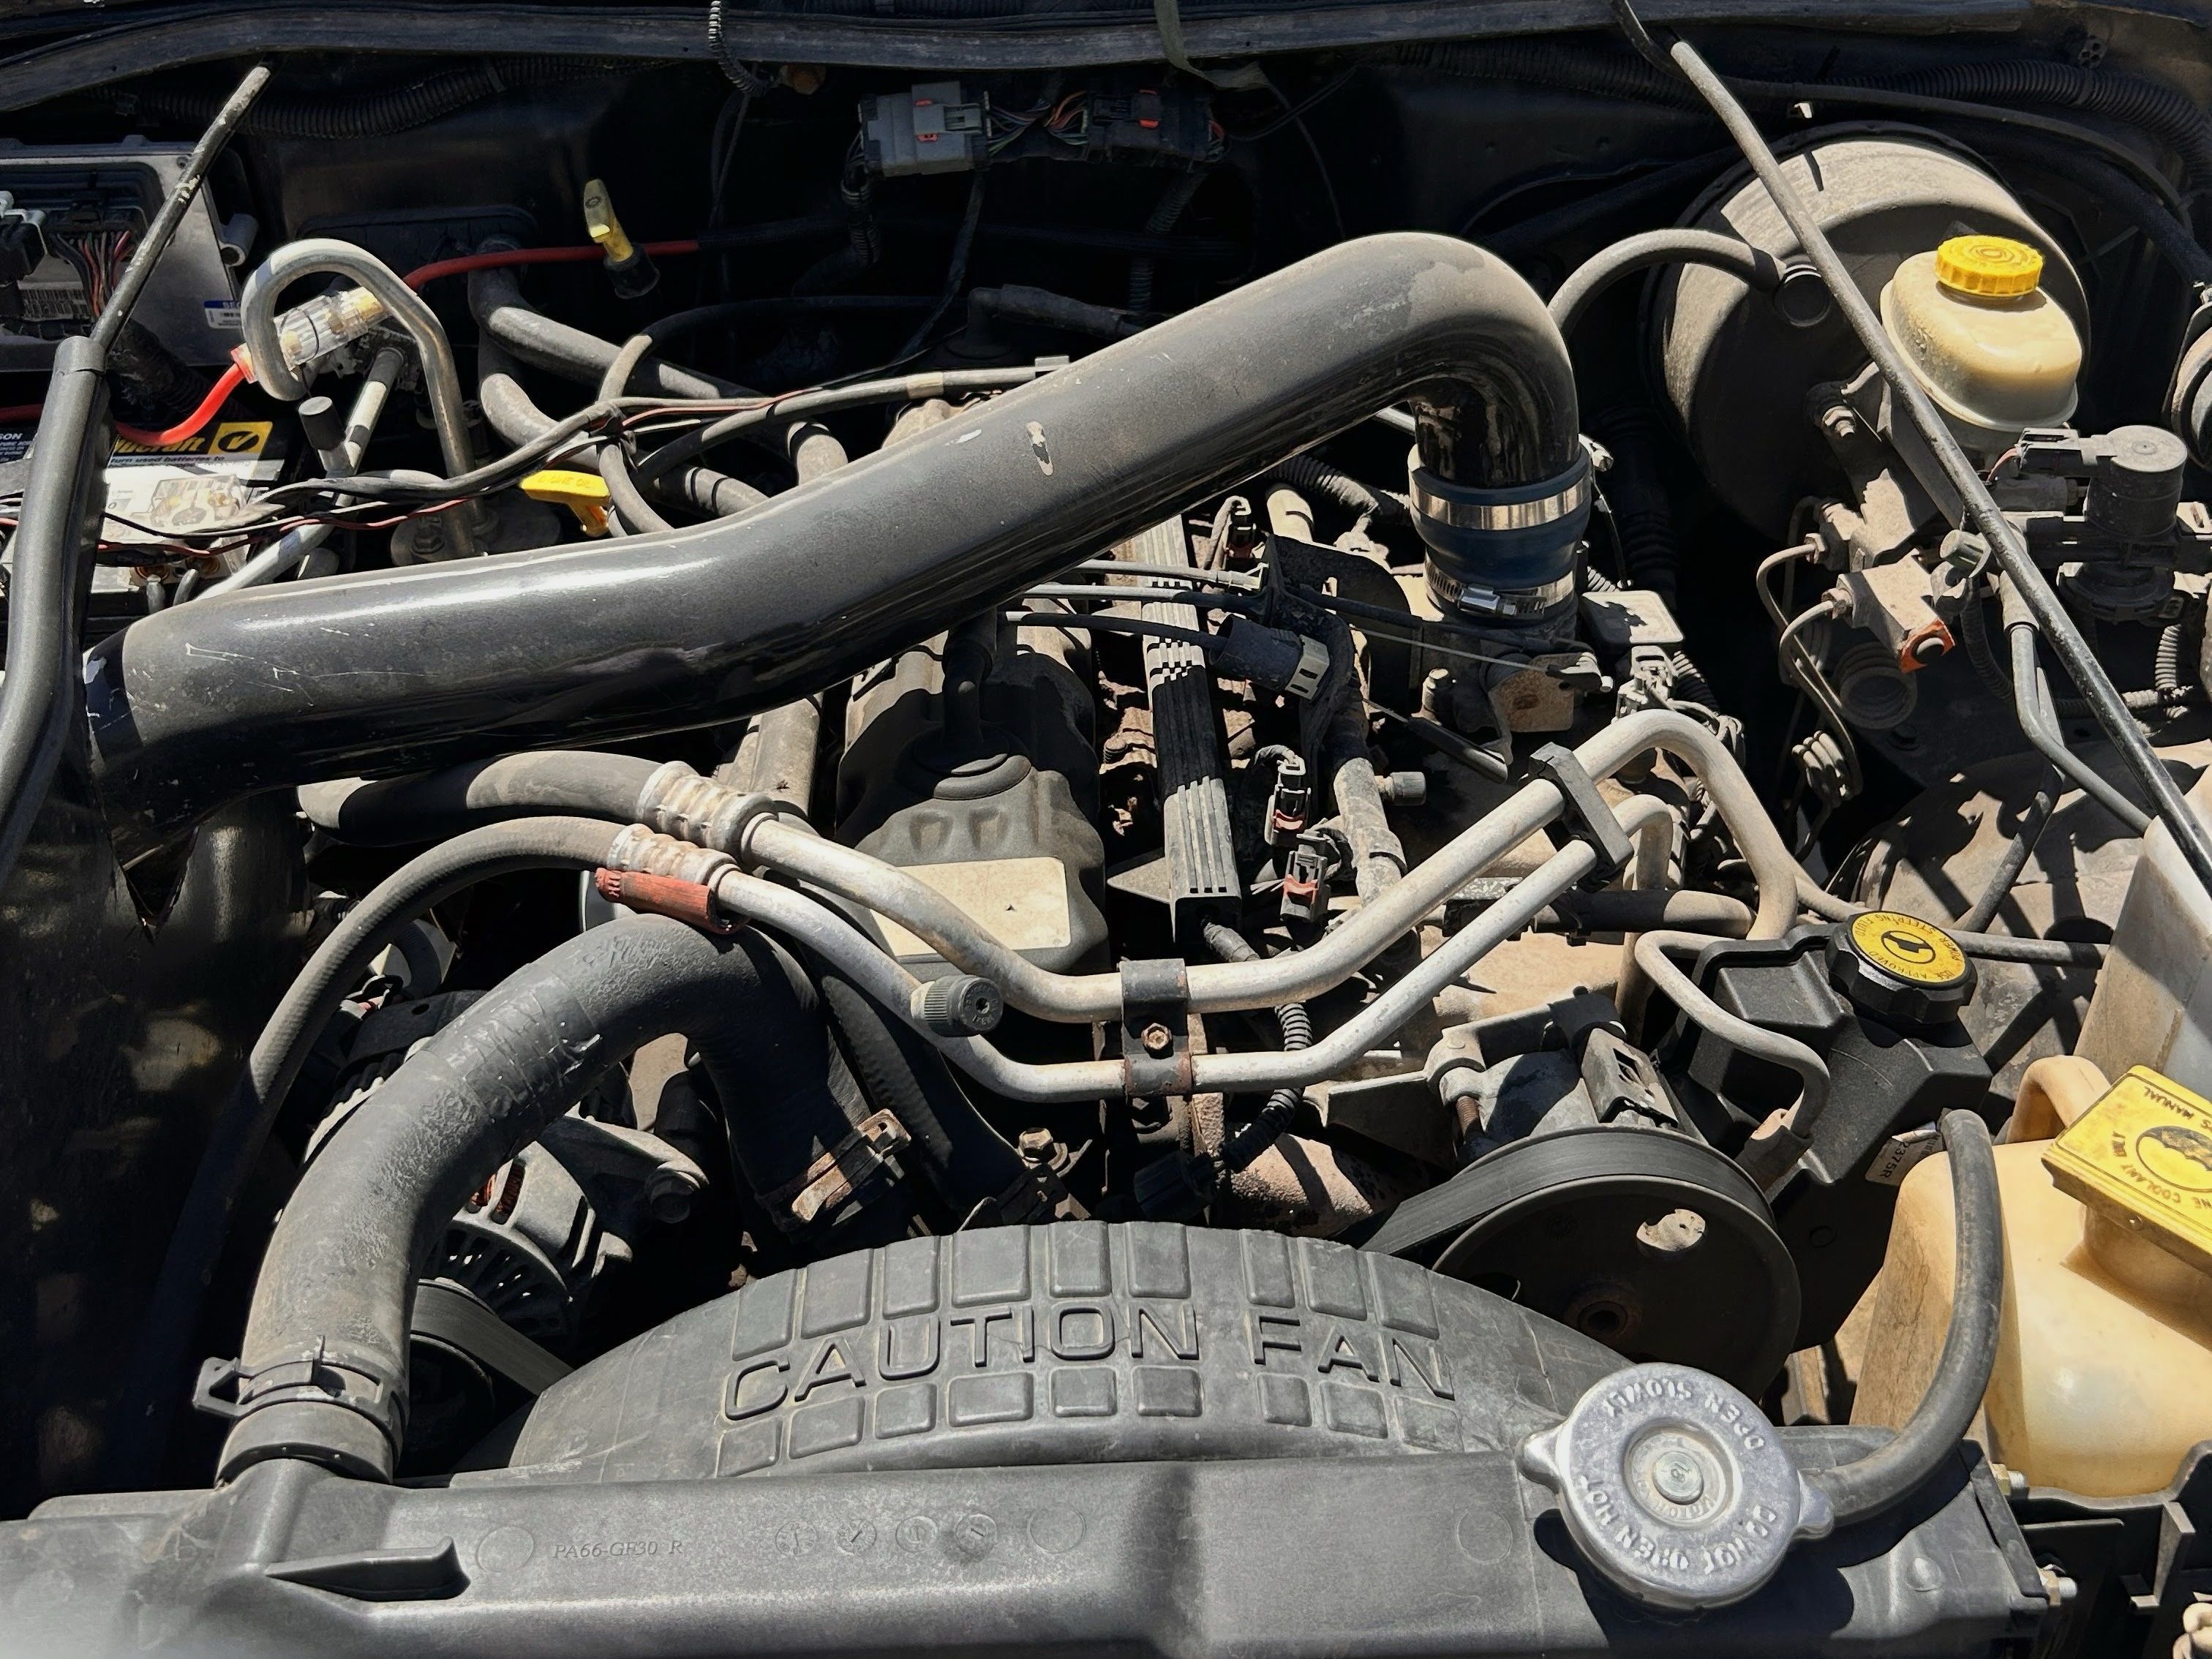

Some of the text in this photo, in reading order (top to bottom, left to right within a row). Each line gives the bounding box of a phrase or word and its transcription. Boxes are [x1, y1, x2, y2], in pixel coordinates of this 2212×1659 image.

[1869, 951, 1927, 979] APPROVED
[1939, 937, 1963, 962] POWER
[723, 1304, 1456, 1421] CAUTION FAN
[1602, 1380, 1766, 1451] OPEN SLOWLY
[553, 1540, 682, 1558] PA66-GF30 R
[1578, 1475, 1777, 1574] DO NOT OPEN HOT
